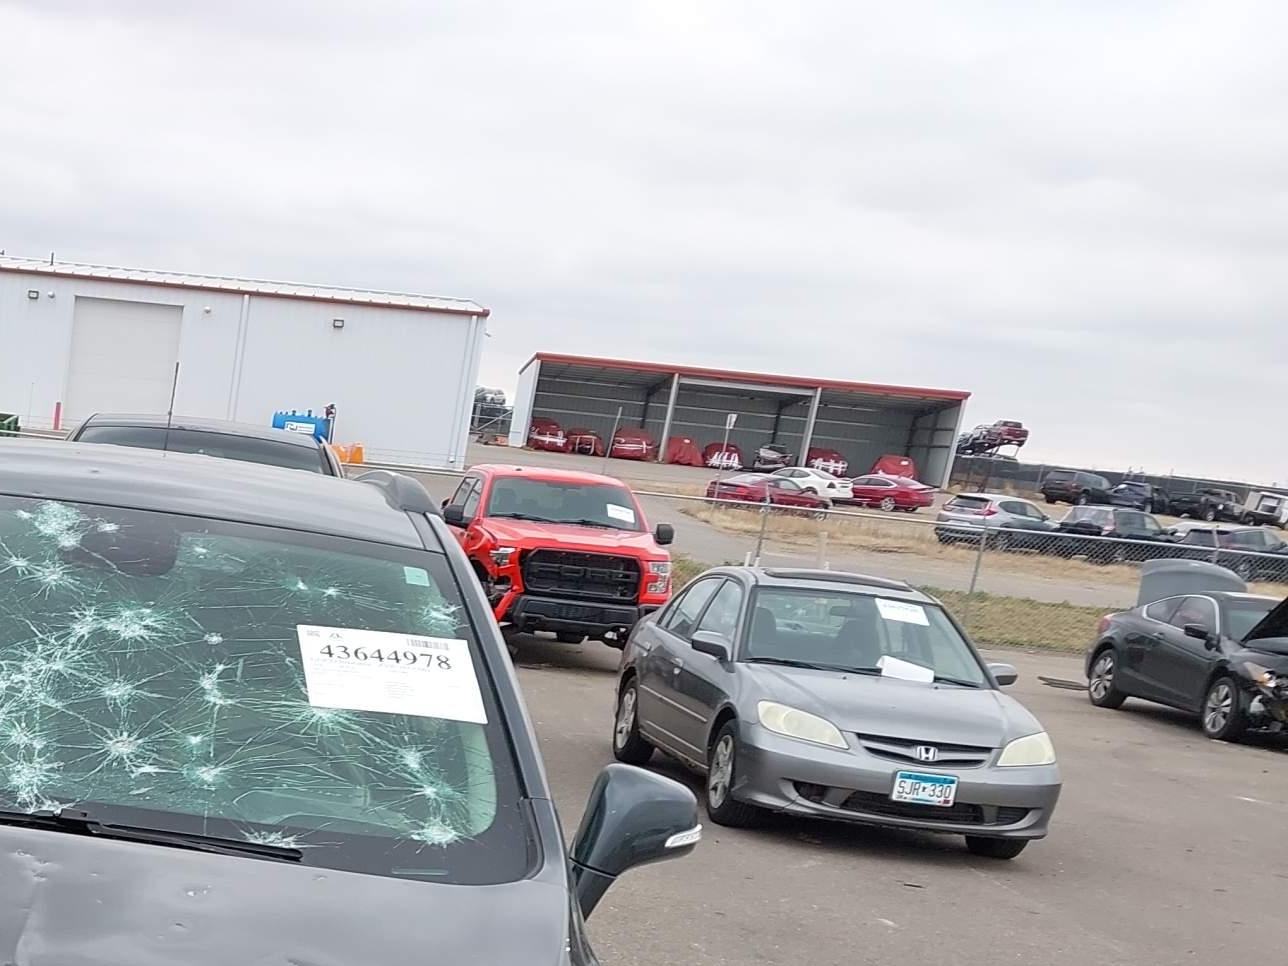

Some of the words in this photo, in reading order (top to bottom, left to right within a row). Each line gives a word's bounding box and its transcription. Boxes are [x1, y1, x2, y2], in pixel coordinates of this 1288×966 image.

[319, 644, 452, 670] 43644978
[897, 780, 921, 796] SJR
[928, 783, 952, 798] 330
